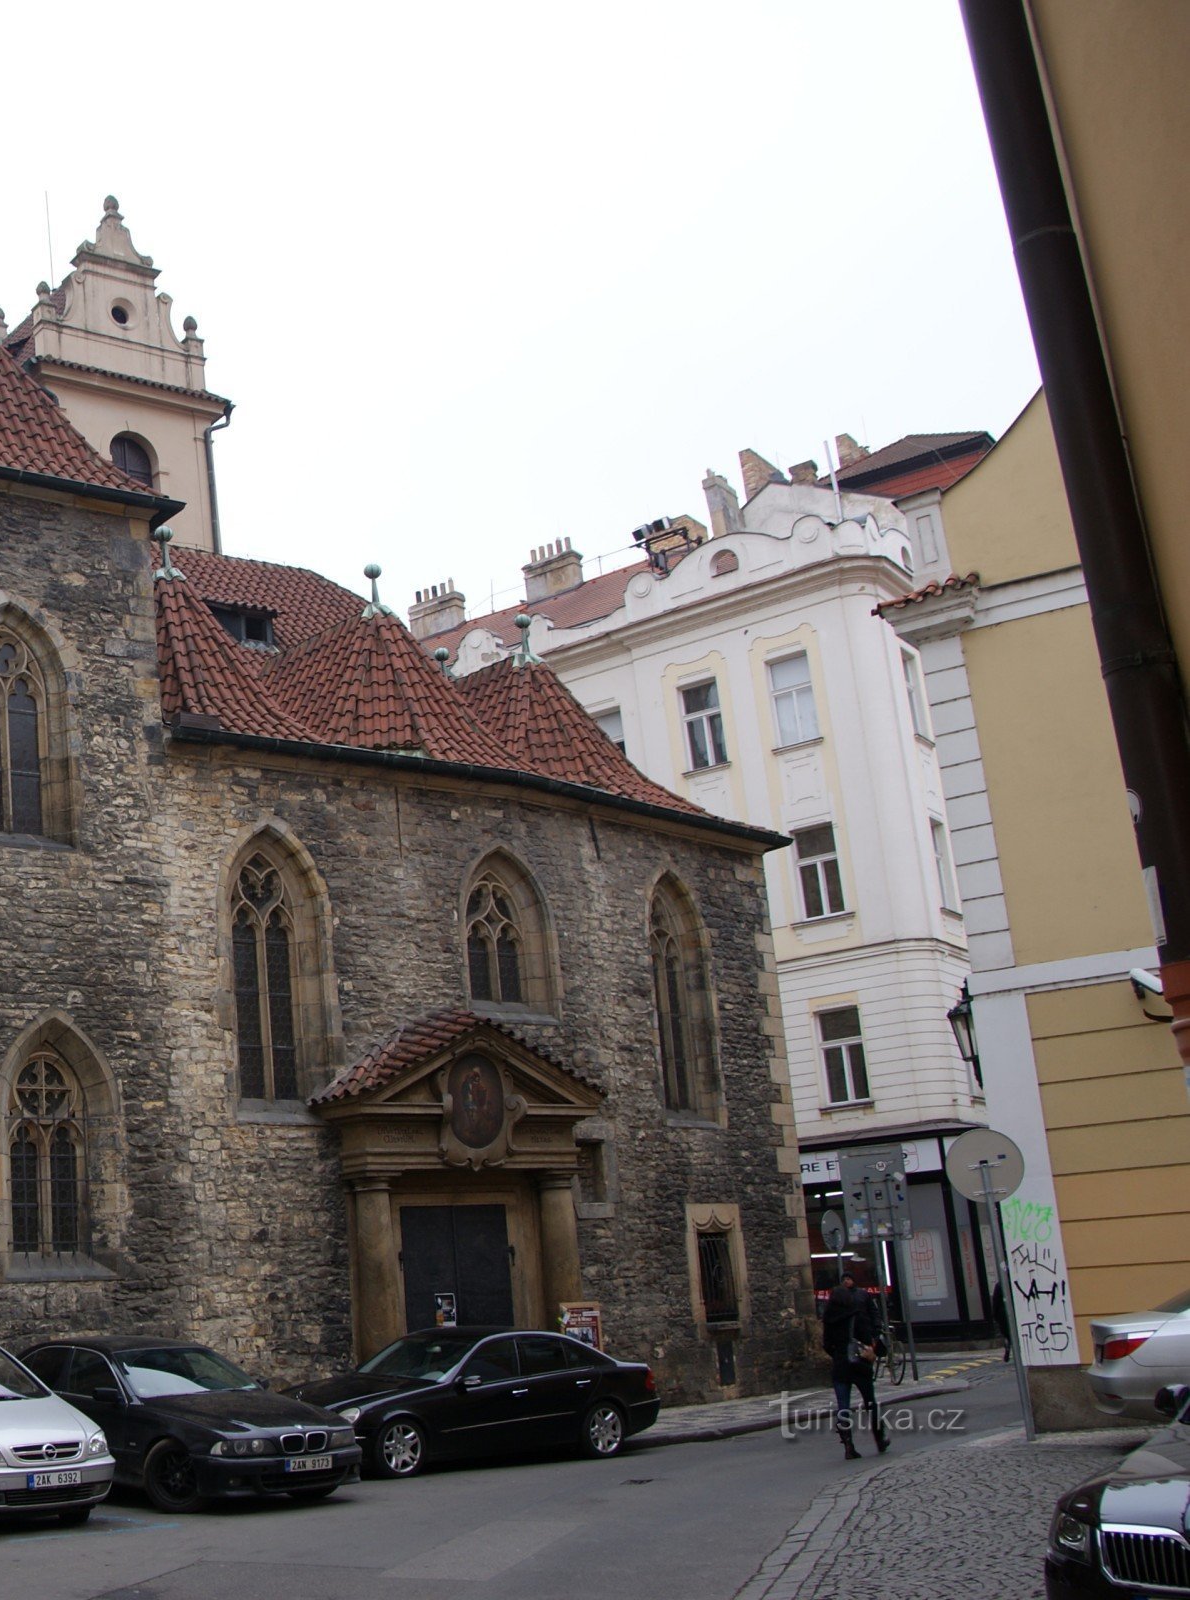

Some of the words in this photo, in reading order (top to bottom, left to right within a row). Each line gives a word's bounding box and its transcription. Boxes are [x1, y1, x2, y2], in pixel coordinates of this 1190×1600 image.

[292, 1460, 307, 1470] 2AN
[311, 1458, 330, 1469] 9173
[36, 1474, 51, 1486] 2AK
[57, 1472, 78, 1484] 6392
